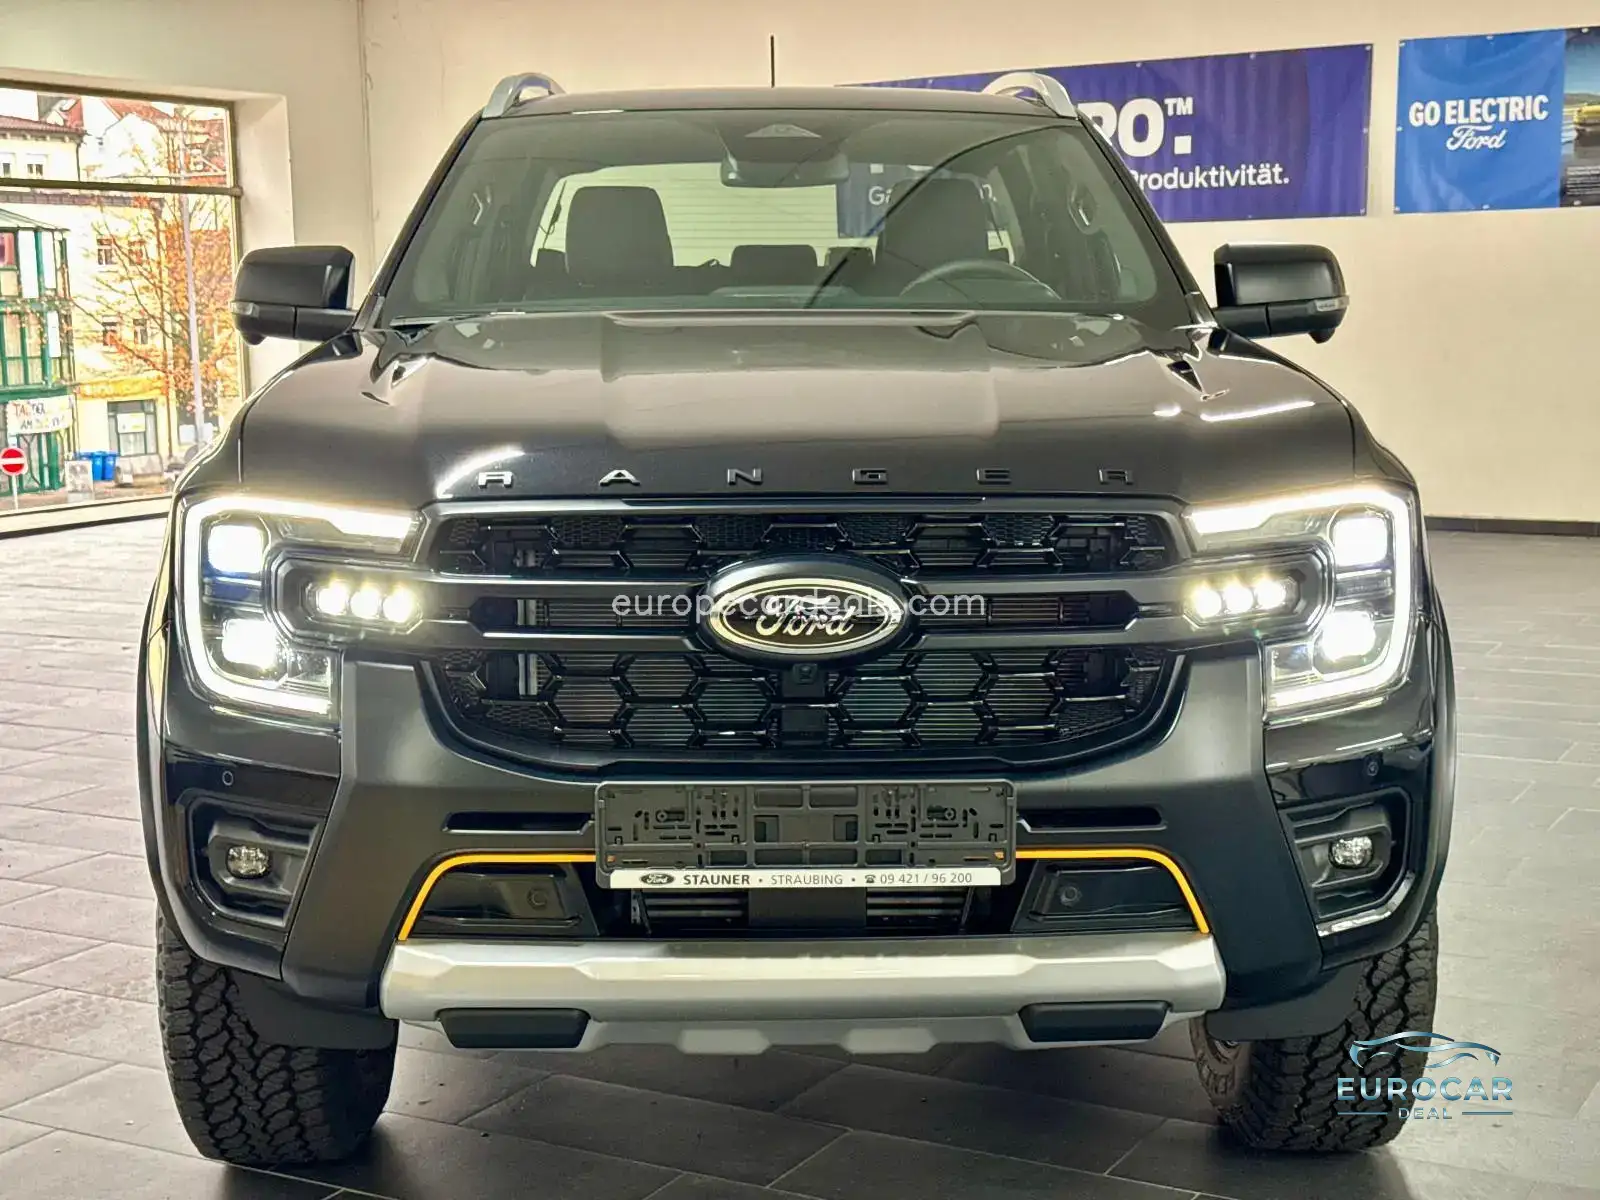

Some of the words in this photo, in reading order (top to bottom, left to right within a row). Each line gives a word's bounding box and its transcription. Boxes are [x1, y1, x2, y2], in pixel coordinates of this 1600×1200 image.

[1409, 101, 1441, 127] GO
[1445, 95, 1549, 125] ELECTRIC
[1446, 125, 1508, 151] Ford
[478, 468, 1134, 488] RANGER
[753, 594, 859, 636] Ford
[683, 874, 750, 885] STAUNER
[770, 874, 843, 885] STRAUBING
[880, 873, 895, 884] 09
[898, 873, 920, 884] 421
[931, 872, 946, 883] 96
[950, 872, 972, 883] 200
